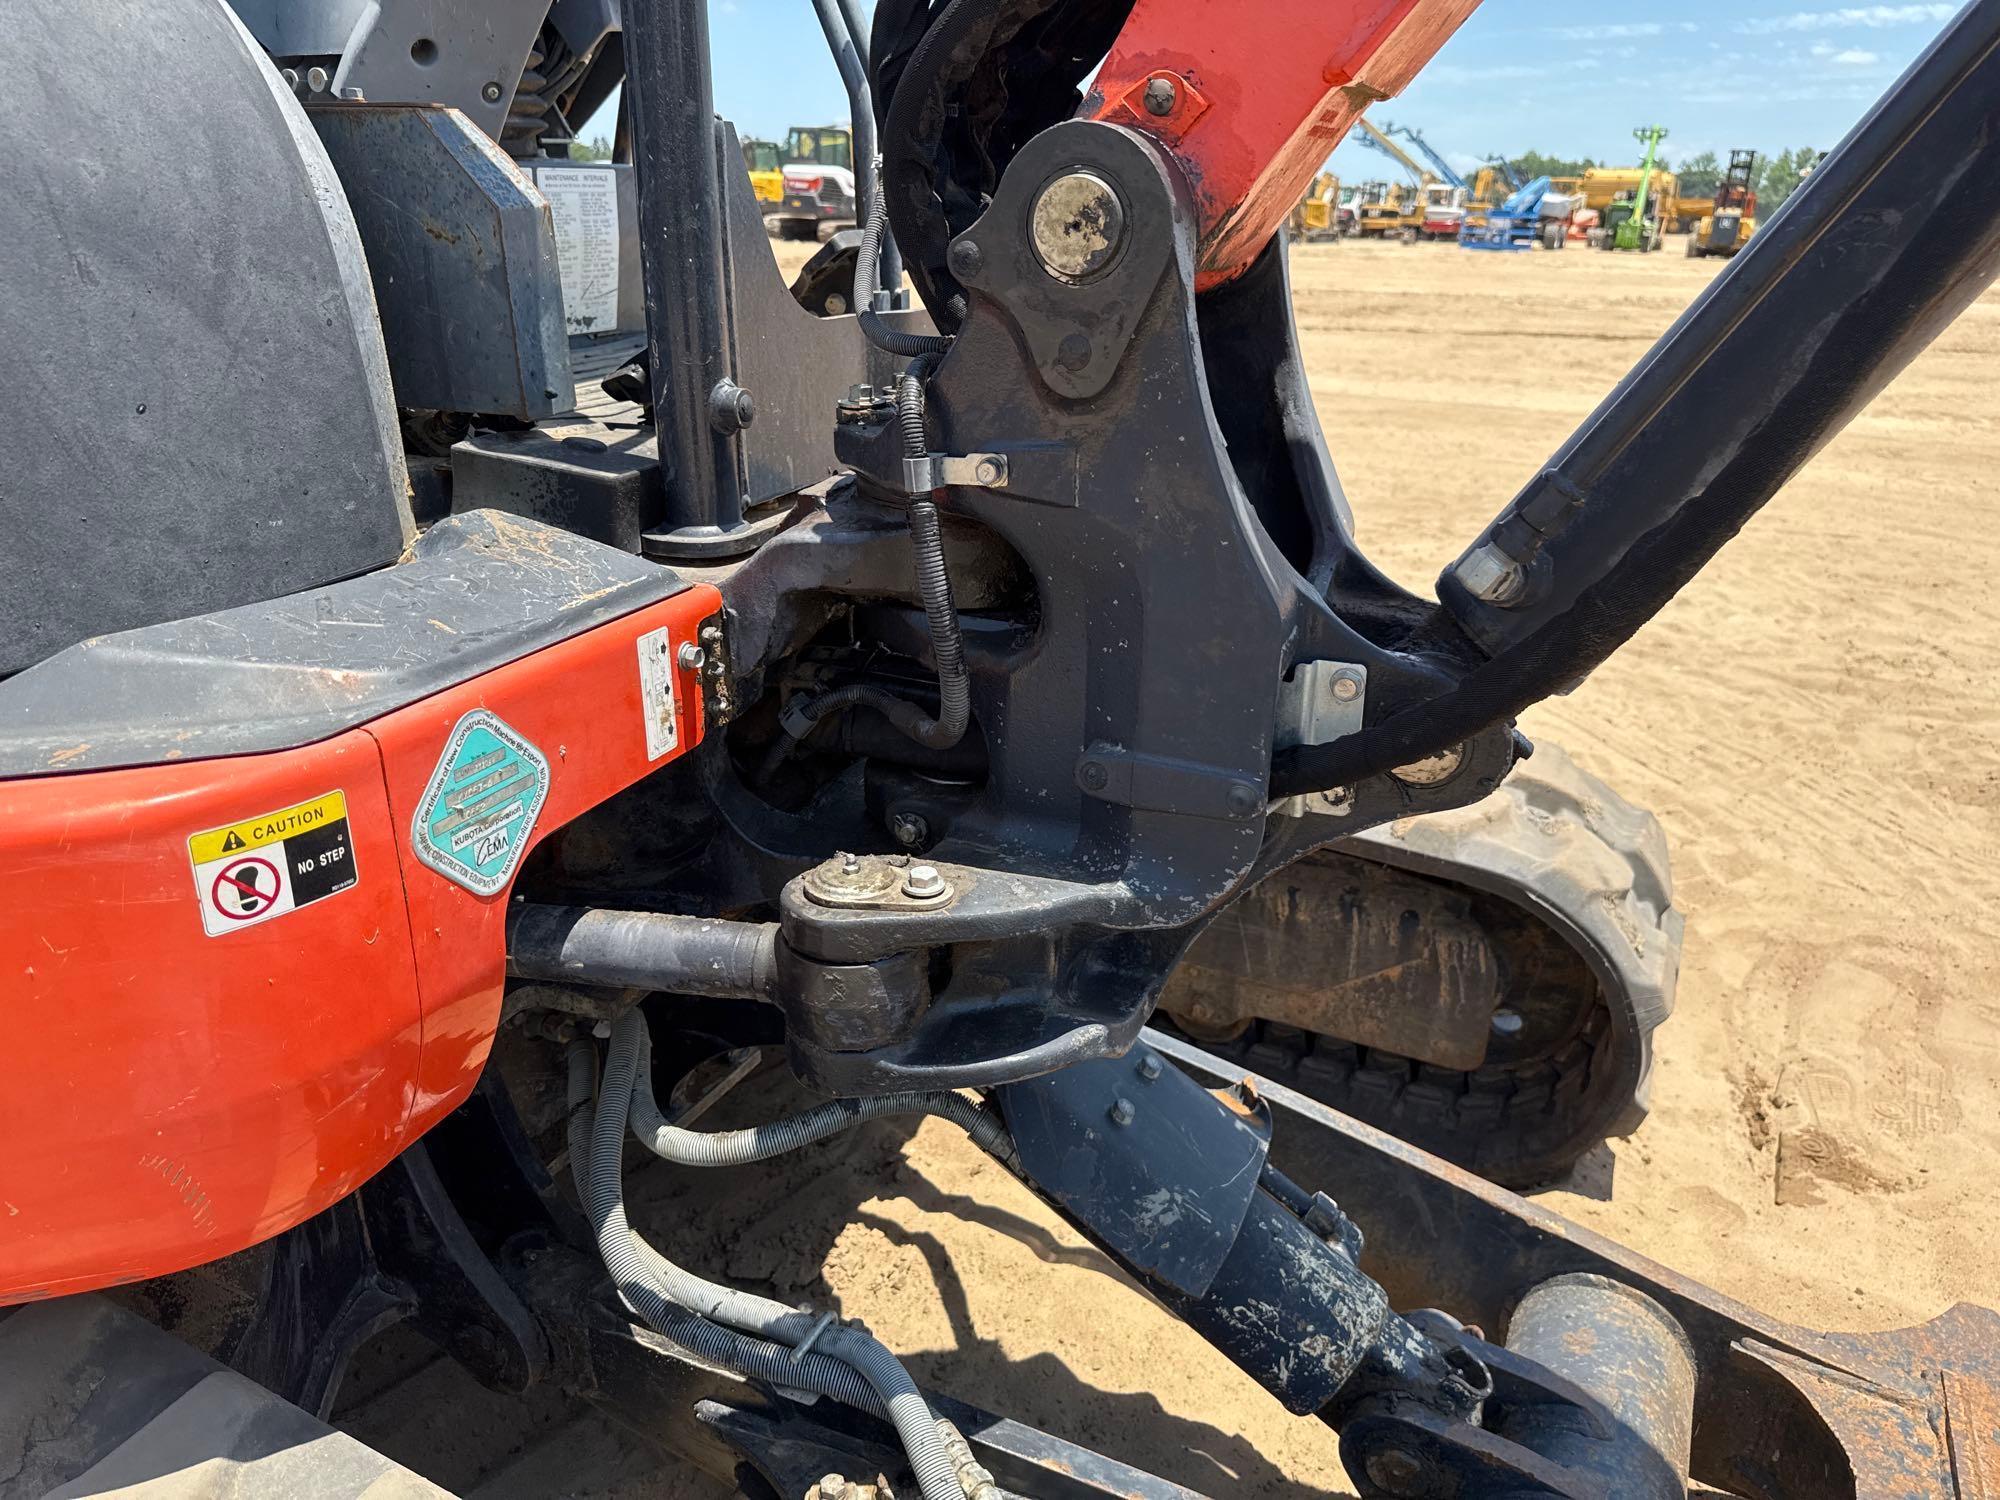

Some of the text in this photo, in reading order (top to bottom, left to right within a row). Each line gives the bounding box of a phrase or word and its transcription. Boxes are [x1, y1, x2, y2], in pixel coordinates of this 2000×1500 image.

[544, 174, 608, 182] MAINTENANCE INTERVALS
[420, 779, 444, 823] Certificate
[442, 765, 449, 778] of
[447, 748, 458, 767] New
[456, 718, 494, 747] Construction
[494, 725, 516, 746] Machine
[522, 748, 542, 767] Export
[253, 807, 324, 840] CAUTION
[431, 849, 470, 878] CONSTRUCTION
[469, 871, 501, 889] EQUIPMENT
[502, 815, 533, 877] MANUFACTURERS
[531, 766, 547, 815] ASSOCIATION
[454, 826, 484, 847] KUBOTA
[484, 806, 522, 831] Corporation
[297, 846, 345, 875] NO STEP
